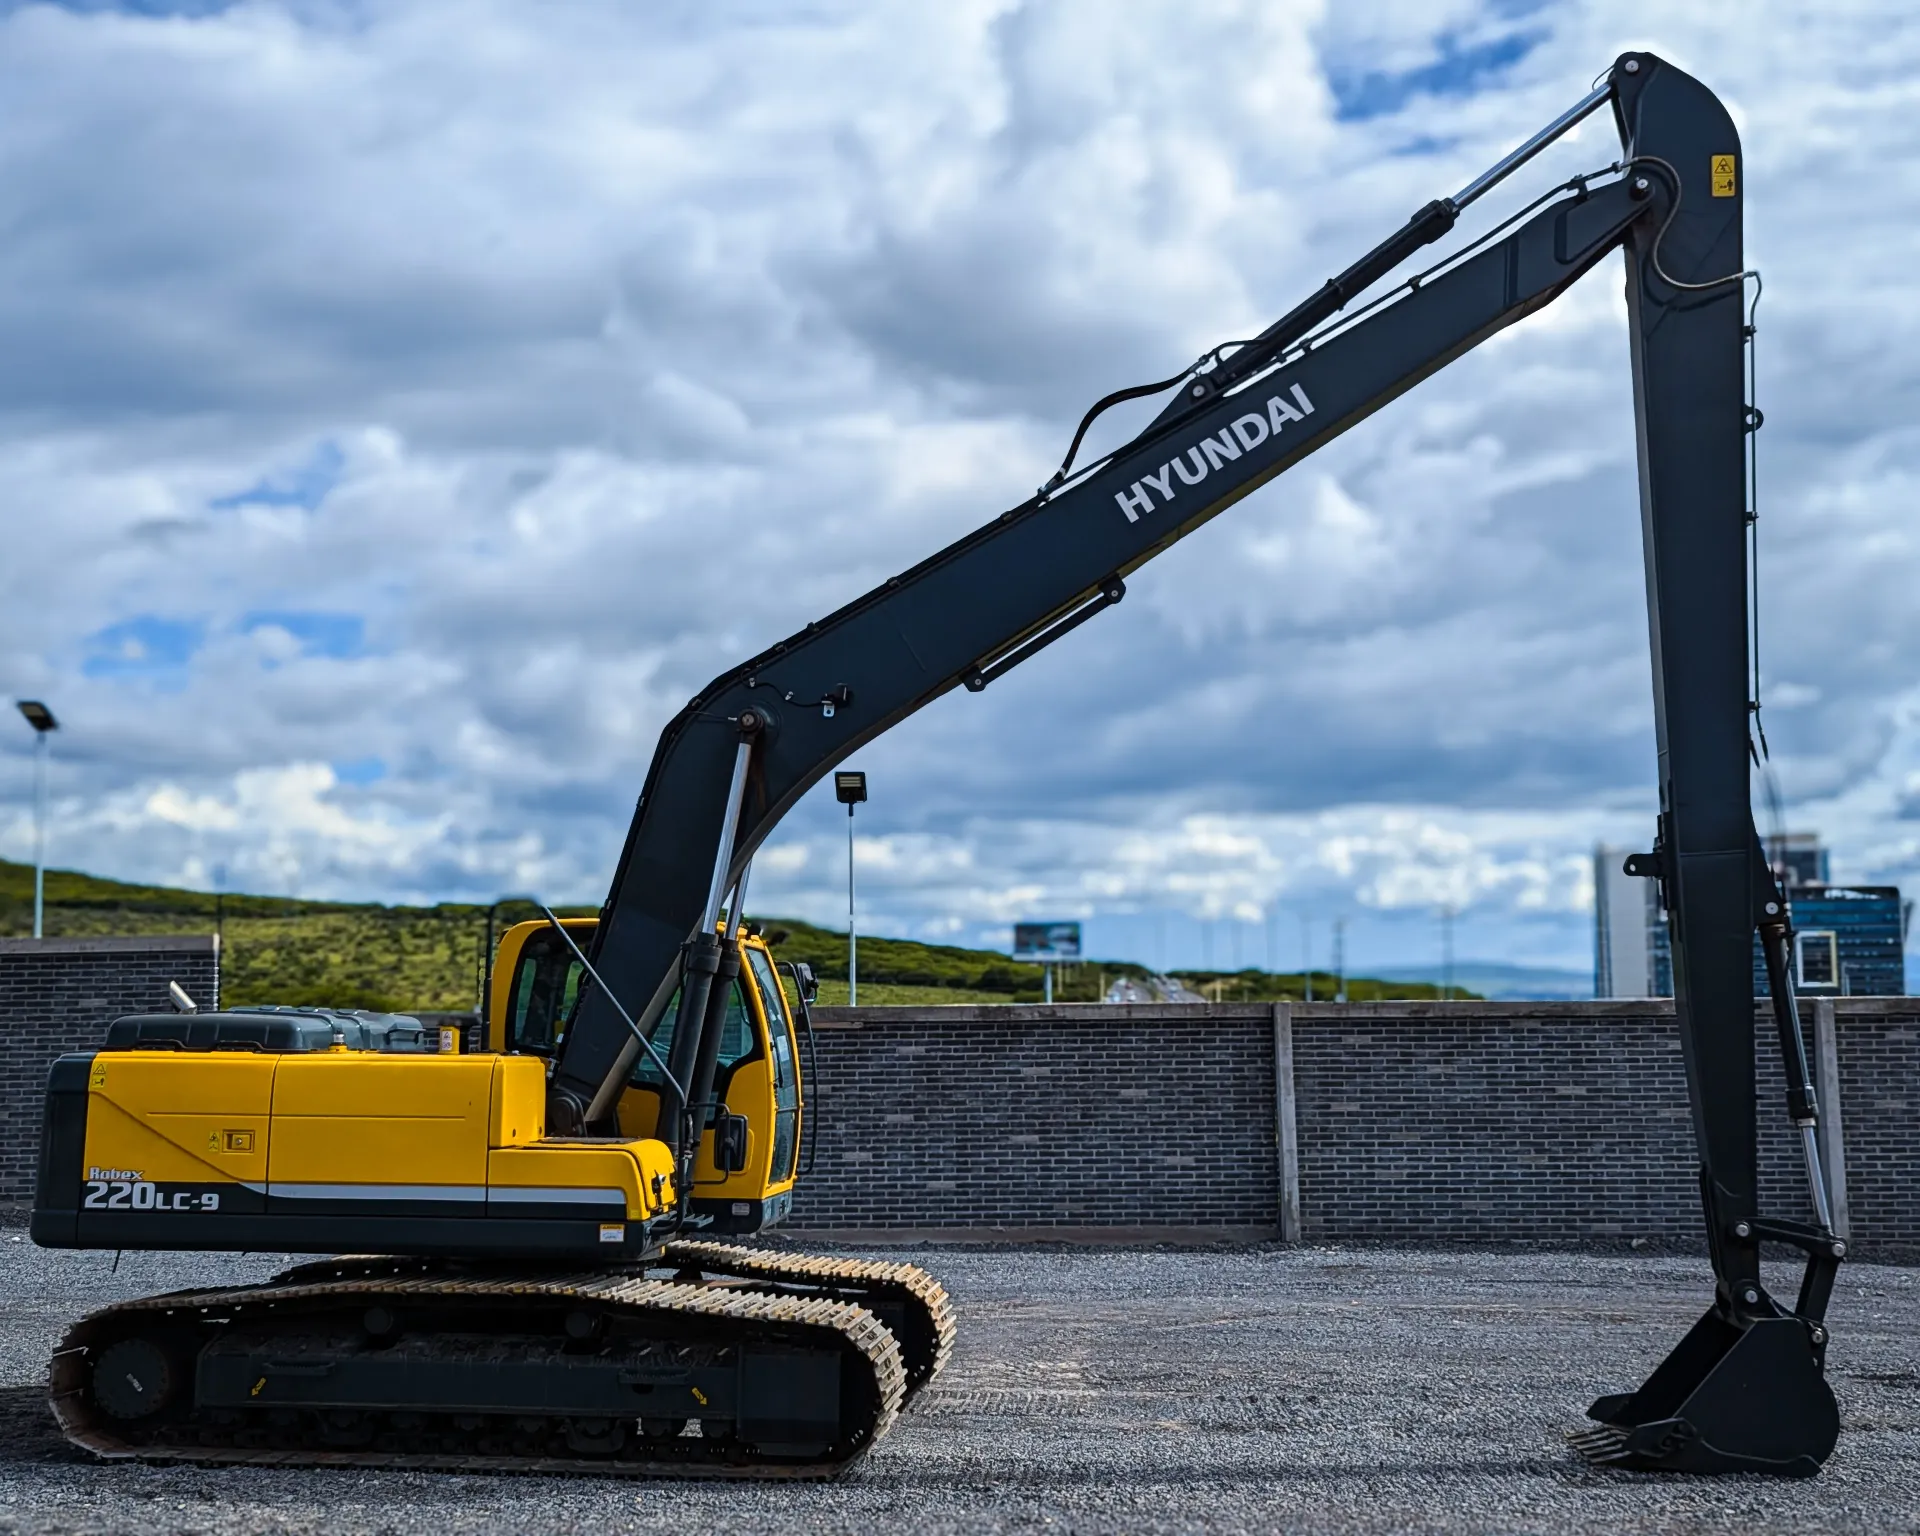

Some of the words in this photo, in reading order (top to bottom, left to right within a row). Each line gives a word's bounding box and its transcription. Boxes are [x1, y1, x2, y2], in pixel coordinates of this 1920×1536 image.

[1114, 382, 1315, 523] HYUNDAI
[89, 1166, 143, 1180] Robex
[84, 1181, 220, 1210] 220LC-9
